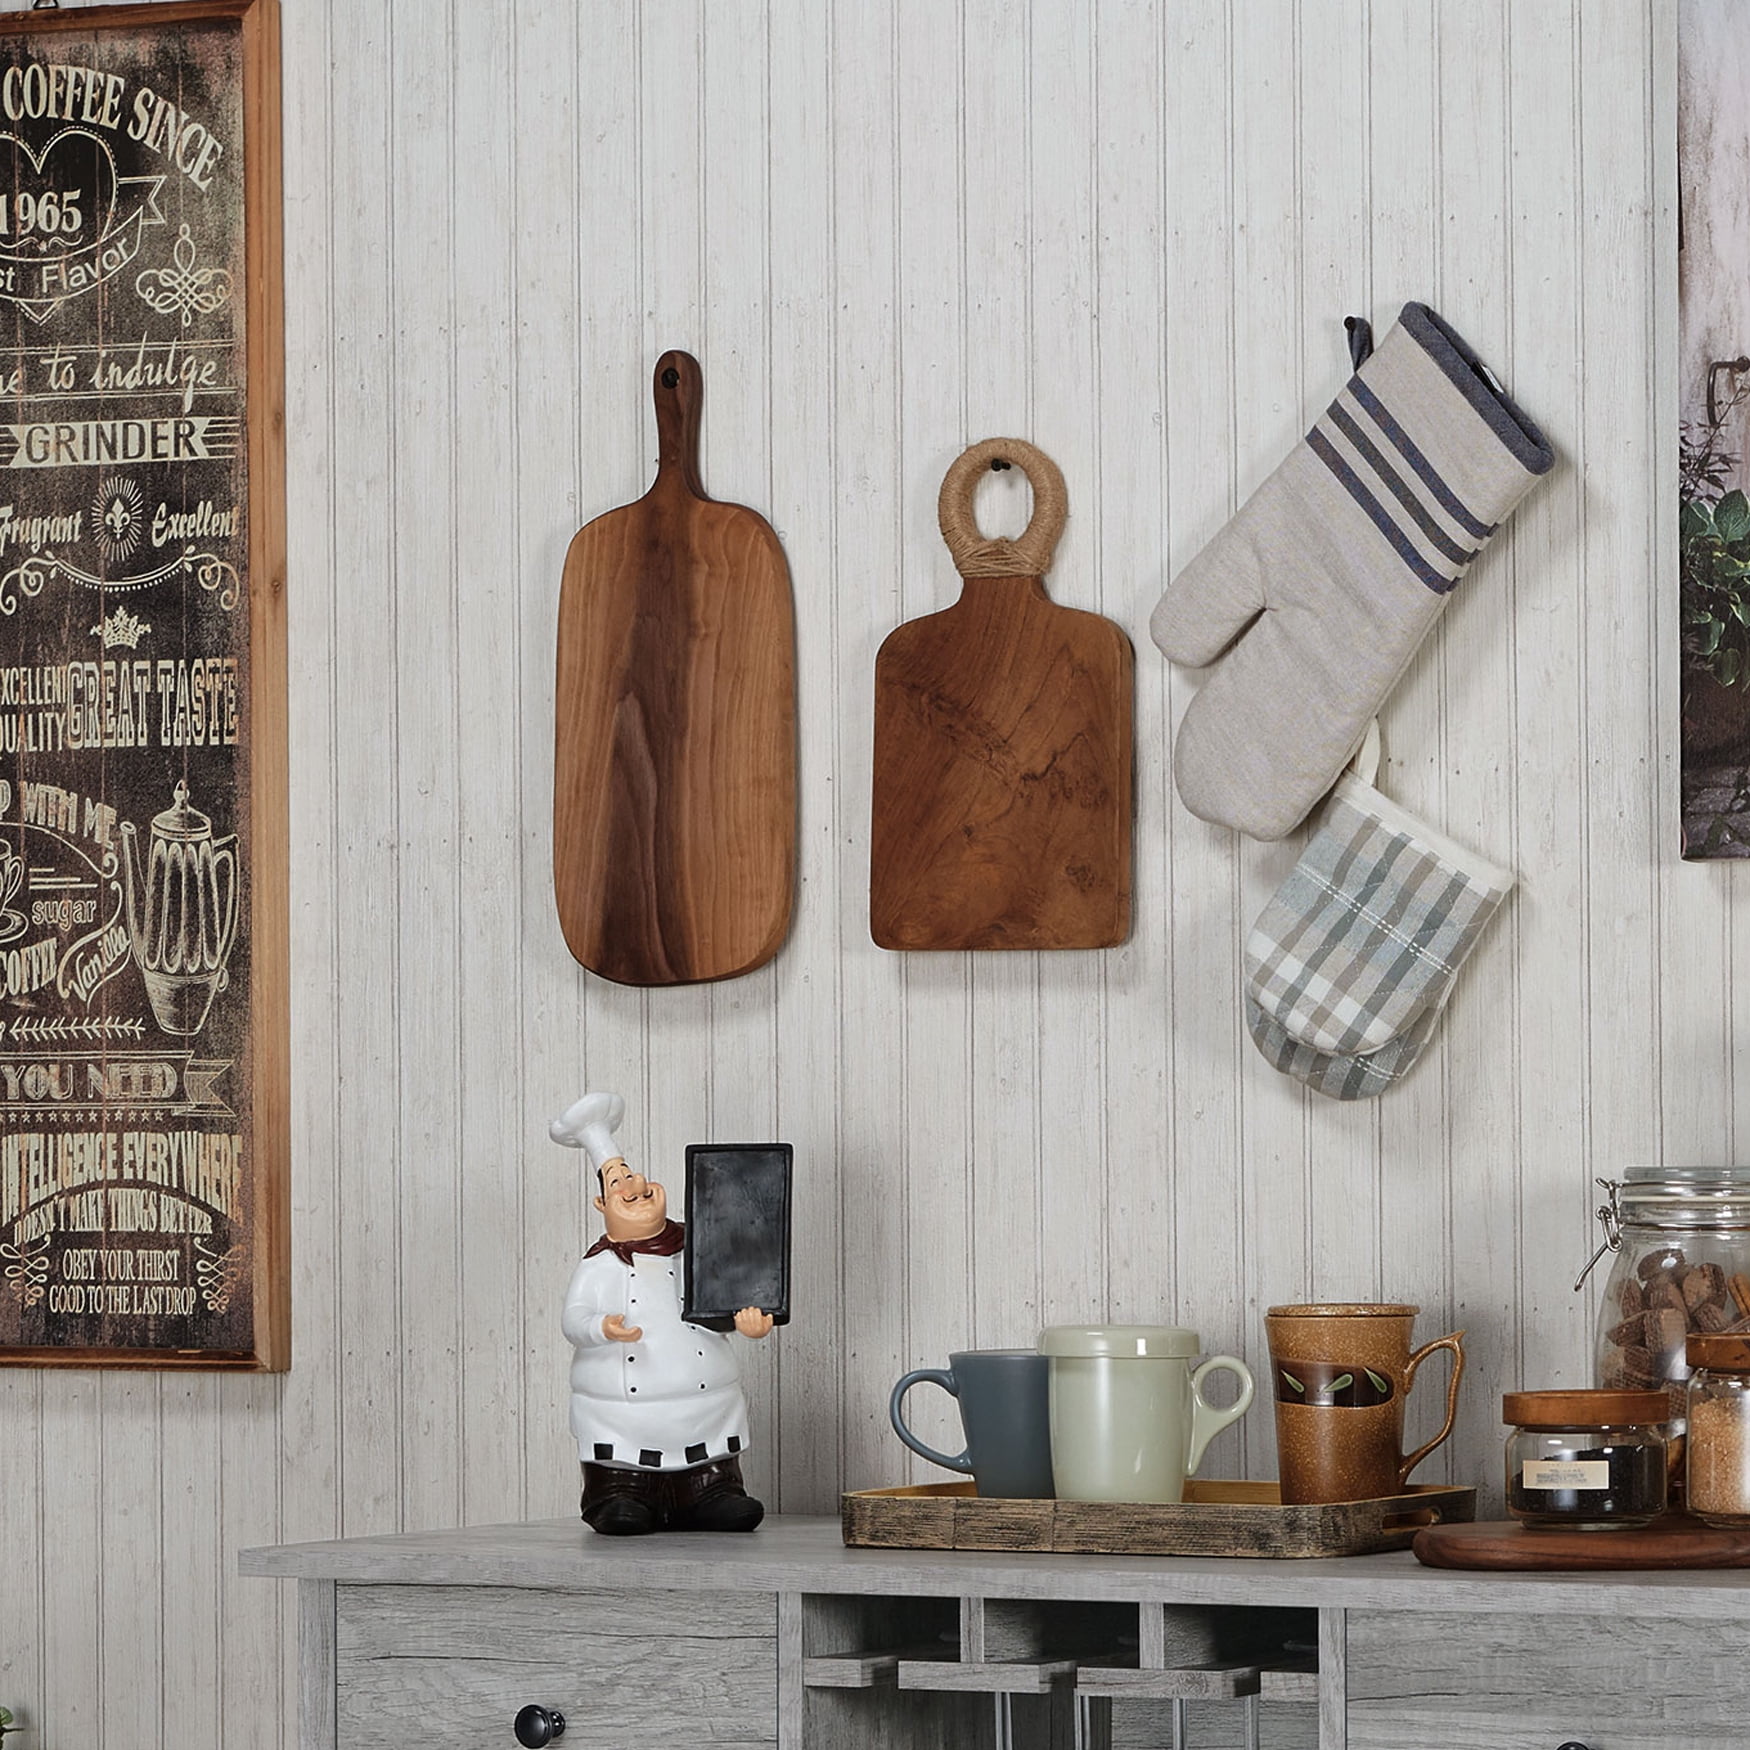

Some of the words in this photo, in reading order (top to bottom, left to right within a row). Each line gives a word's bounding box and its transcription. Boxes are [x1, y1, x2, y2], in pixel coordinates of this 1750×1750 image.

[3, 63, 125, 130] COFFEE
[126, 87, 224, 192] SINCE
[0, 188, 83, 236] 1965
[41, 236, 128, 293] Flavor
[40, 342, 77, 390] to
[89, 331, 217, 413] indulge
[25, 420, 199, 465] GRINDER
[0, 505, 82, 554] Fragrant
[151, 501, 239, 548] Excellent
[0, 666, 66, 706] XCELLENT
[67, 661, 151, 749] GREAT
[157, 658, 239, 747] TASTE
[0, 712, 66, 753] UALITY
[19, 780, 78, 834] WITH
[83, 797, 118, 850] ME
[31, 900, 97, 932] sugar
[0, 1063, 73, 1100] YOU
[87, 1062, 178, 1100] NEED
[2, 1132, 118, 1229] INTELLIGENCE
[123, 1131, 244, 1229] EVERYWHERE
[68, 1189, 105, 1232] MAKE
[108, 1187, 158, 1232] THINGS
[160, 1193, 213, 1235] BETTER
[62, 1249, 98, 1281] OBEY
[100, 1249, 135, 1281] YOUR
[136, 1250, 181, 1281] THIRST
[49, 1285, 86, 1314] GOOD
[87, 1285, 104, 1314] TO
[105, 1285, 132, 1314] THE
[133, 1285, 164, 1315] LAST
[165, 1286, 197, 1316] DROP
